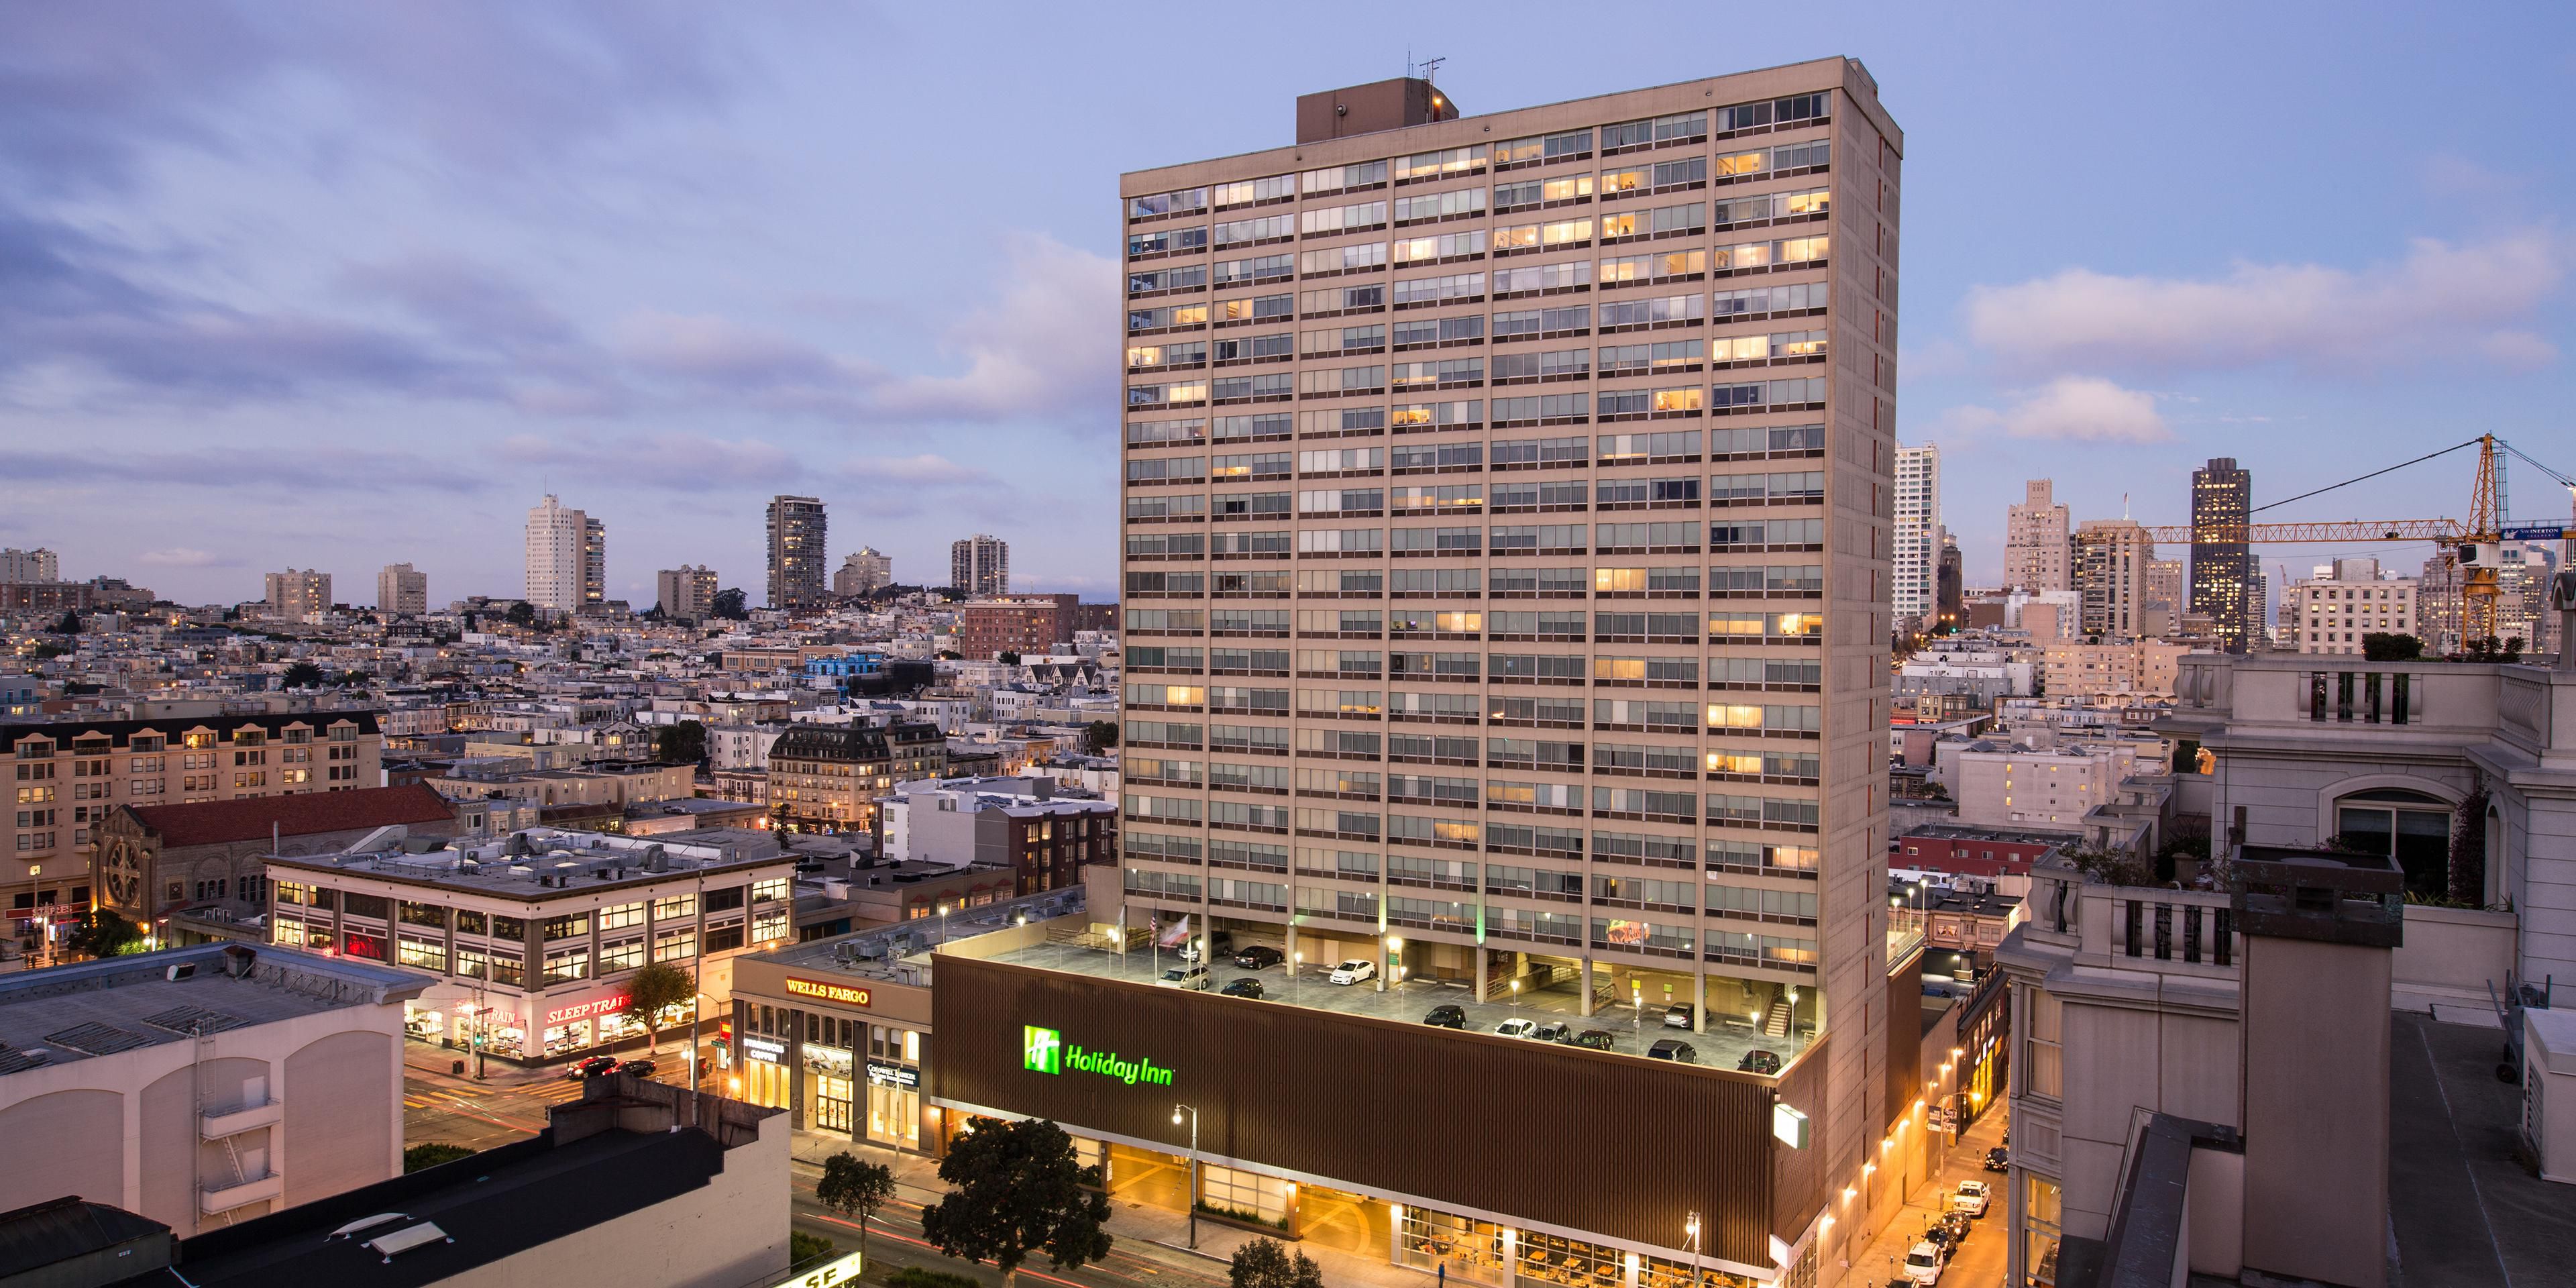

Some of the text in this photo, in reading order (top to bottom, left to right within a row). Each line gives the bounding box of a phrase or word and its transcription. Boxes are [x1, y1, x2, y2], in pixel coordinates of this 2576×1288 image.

[786, 979, 868, 1004] WELLS FARGO
[547, 996, 633, 1024] SLEEP TRAI
[1065, 1044, 1173, 1085] Holiday Inn
